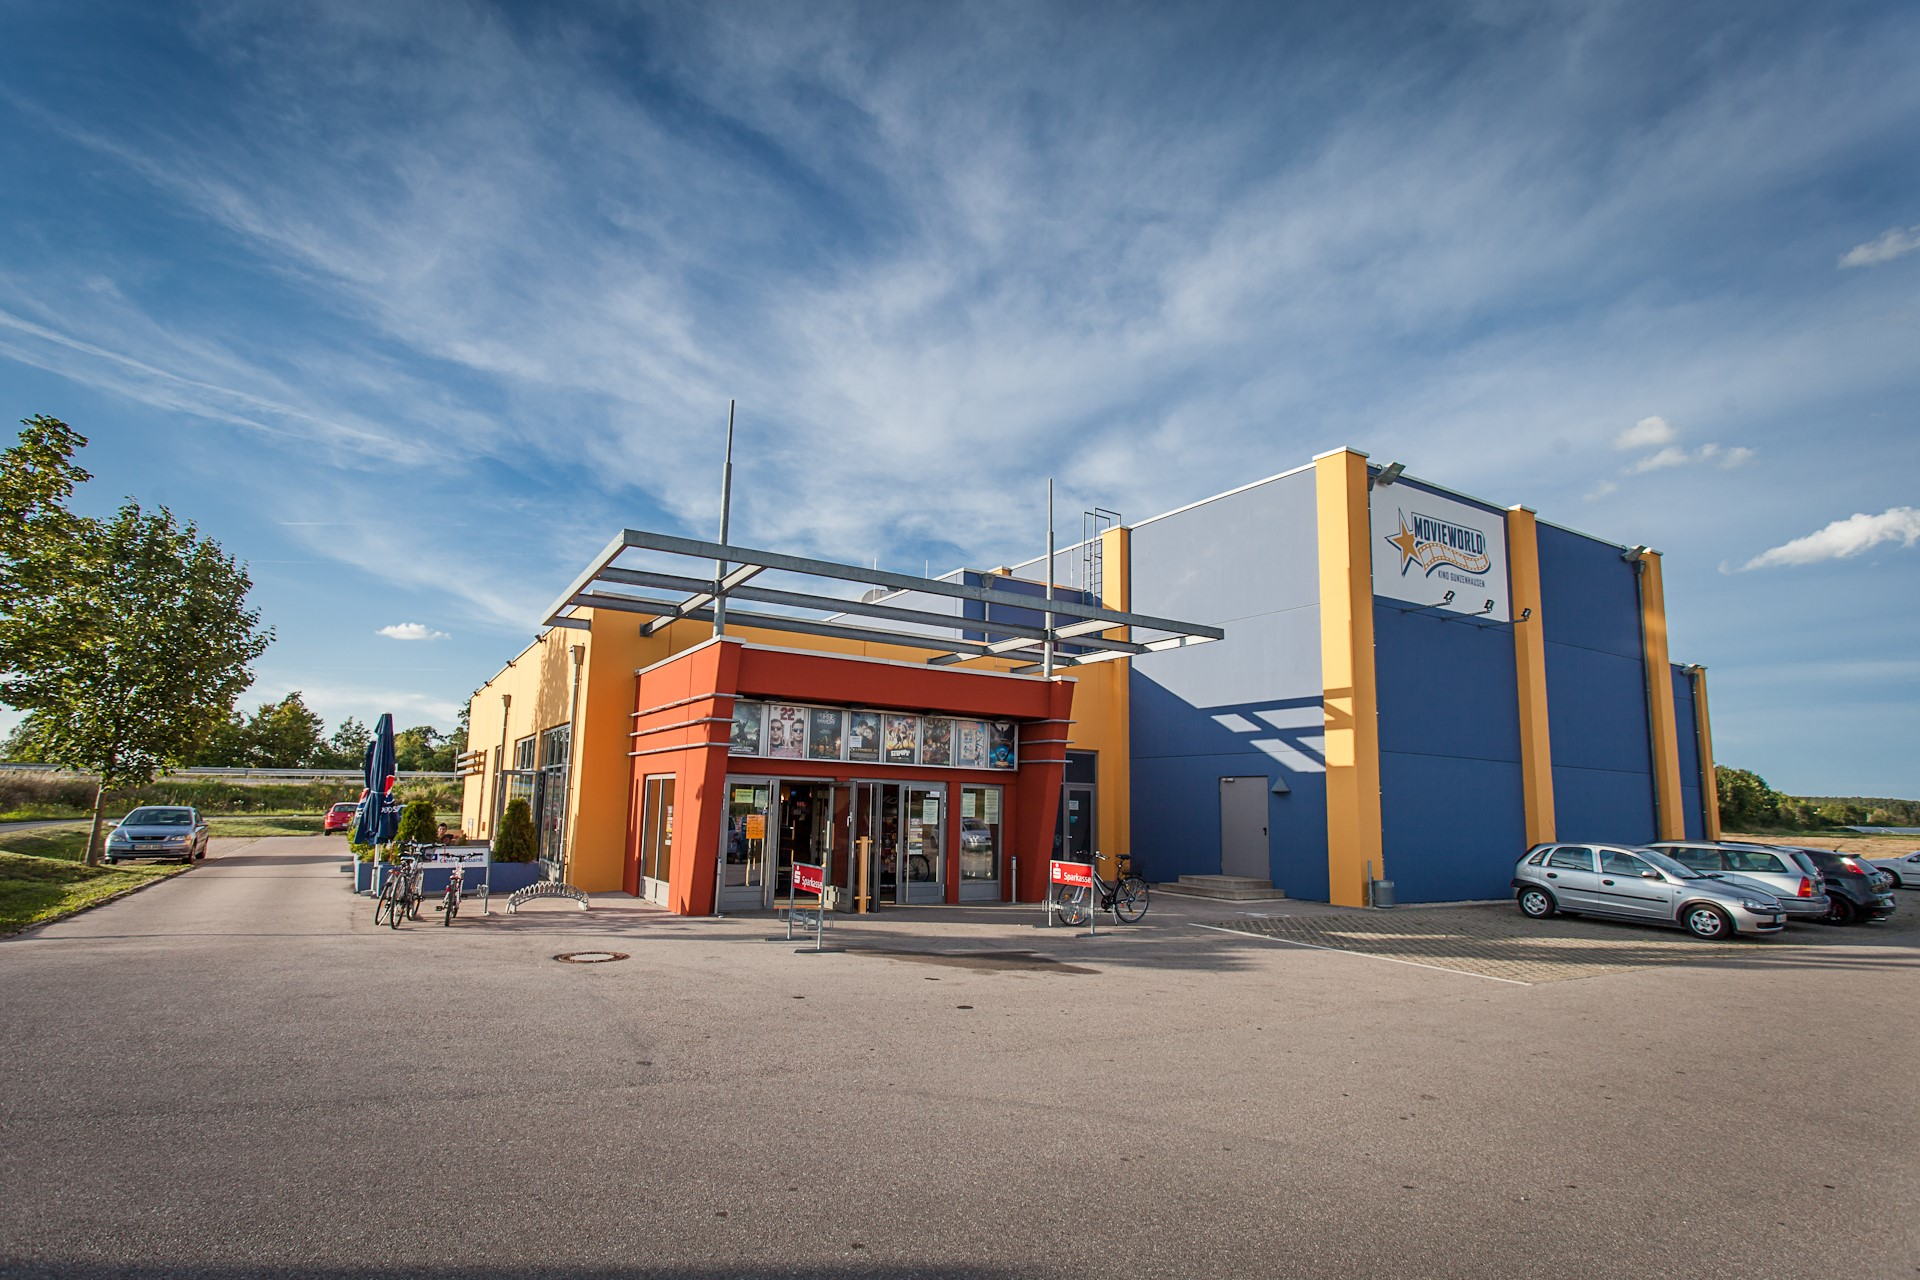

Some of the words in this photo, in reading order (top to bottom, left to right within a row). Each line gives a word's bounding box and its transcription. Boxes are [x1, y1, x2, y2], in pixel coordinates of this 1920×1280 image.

[1414, 516, 1483, 555] MOVIEWORLD
[1438, 570, 1449, 580] KINO
[780, 706, 795, 721] 22
[802, 875, 823, 889] Sparkasse
[1063, 871, 1092, 884] Sparkasse
